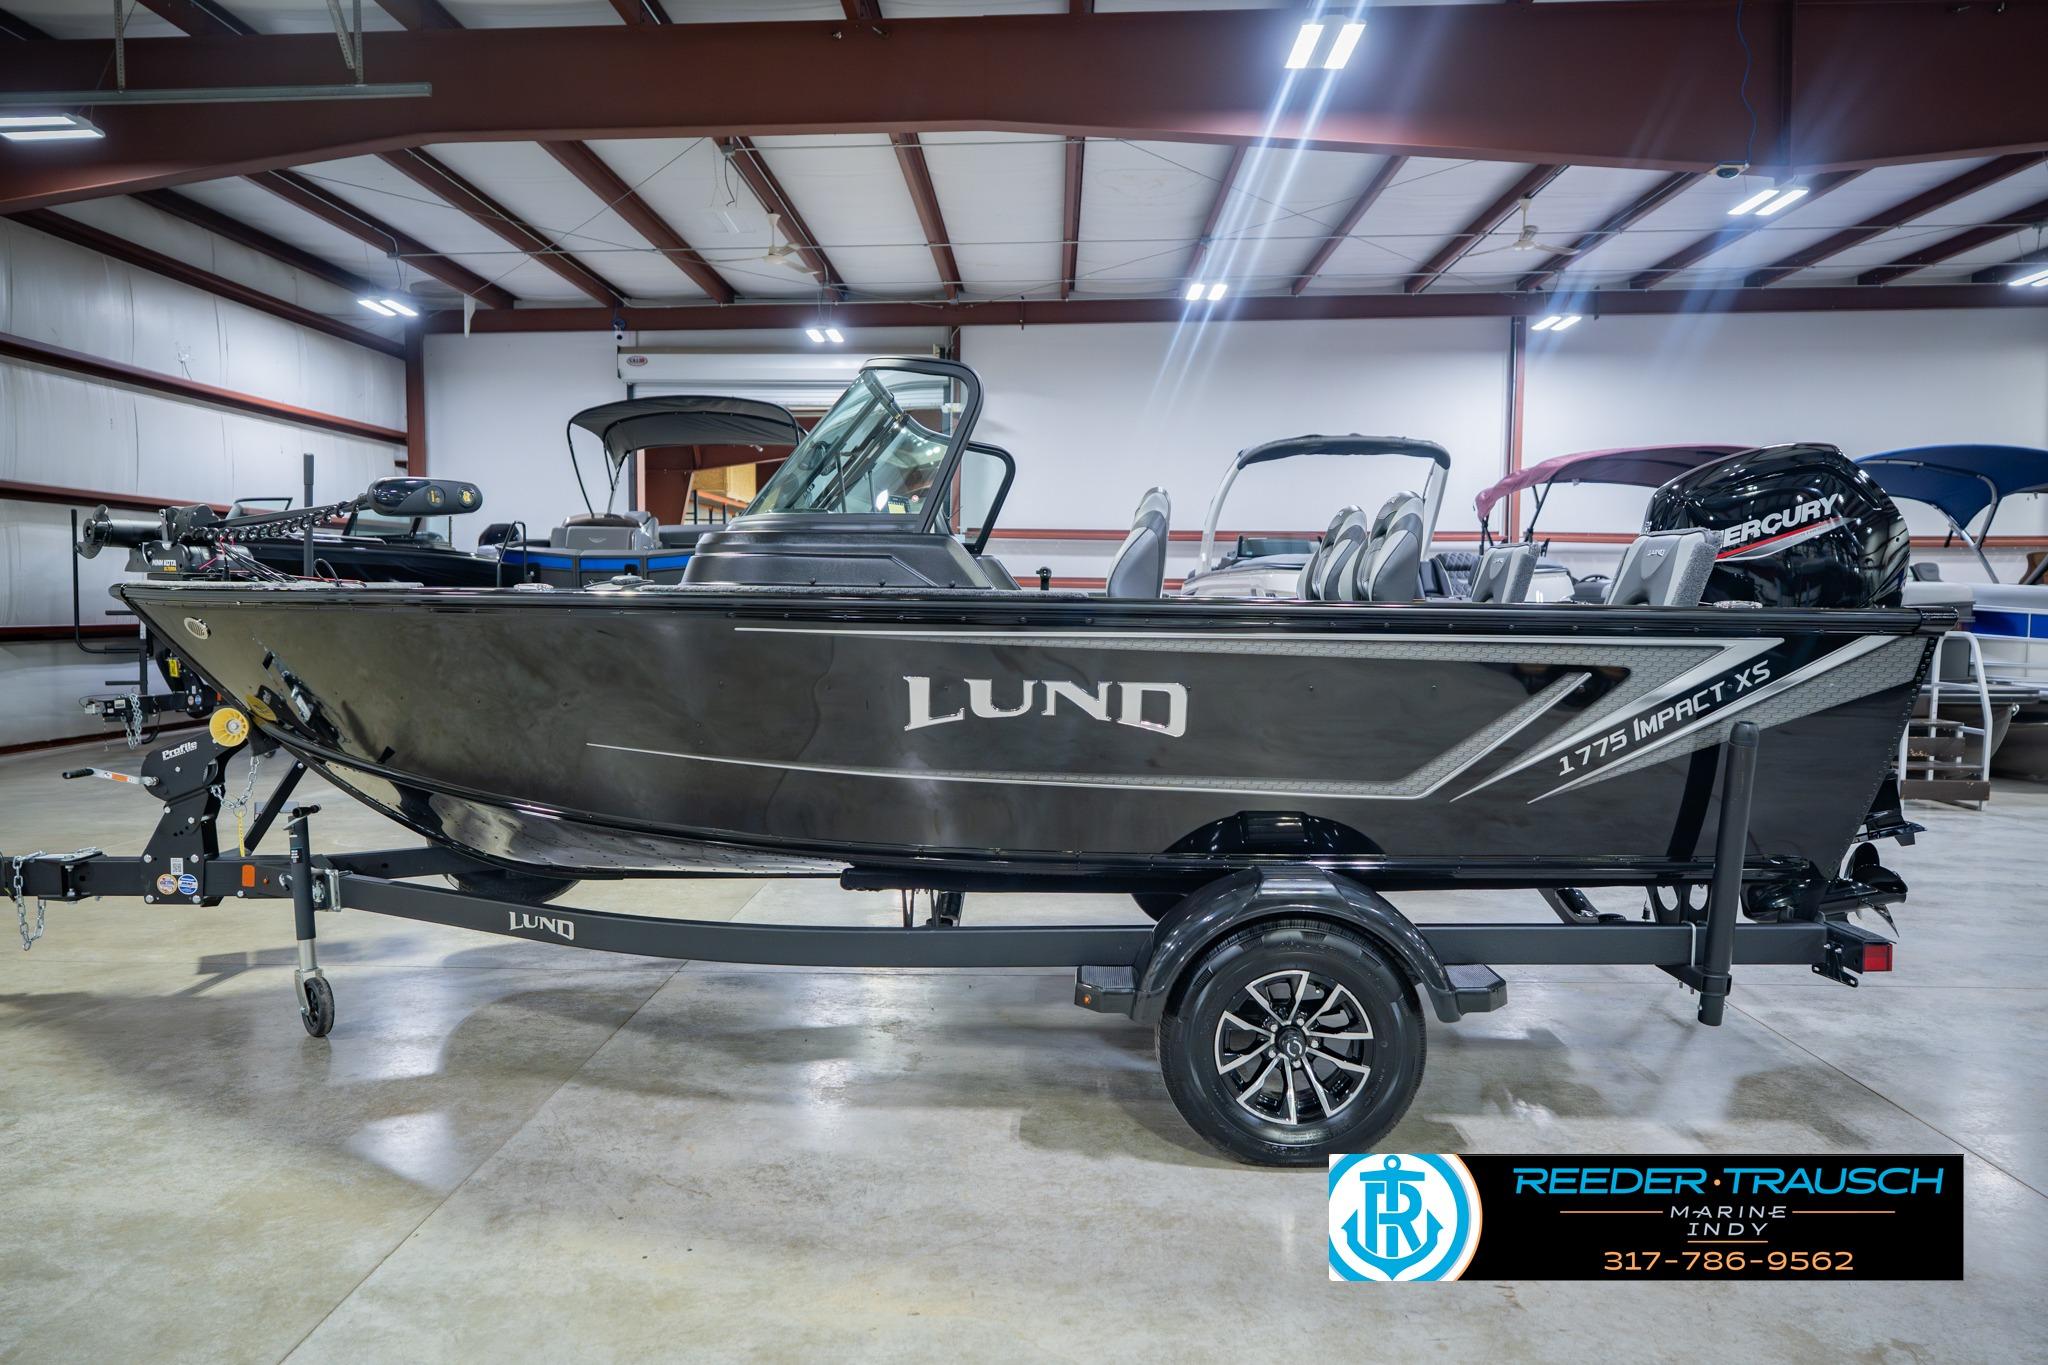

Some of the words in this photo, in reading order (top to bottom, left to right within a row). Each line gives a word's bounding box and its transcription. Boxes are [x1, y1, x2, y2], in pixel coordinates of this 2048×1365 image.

[1720, 493, 1839, 548] ERCURY
[903, 675, 1188, 738] LUND
[1558, 728, 1627, 776] 1775
[1633, 680, 1725, 741] IMPACT
[1734, 659, 1771, 693] XS
[161, 741, 198, 760] Profile
[508, 911, 575, 941] LUND
